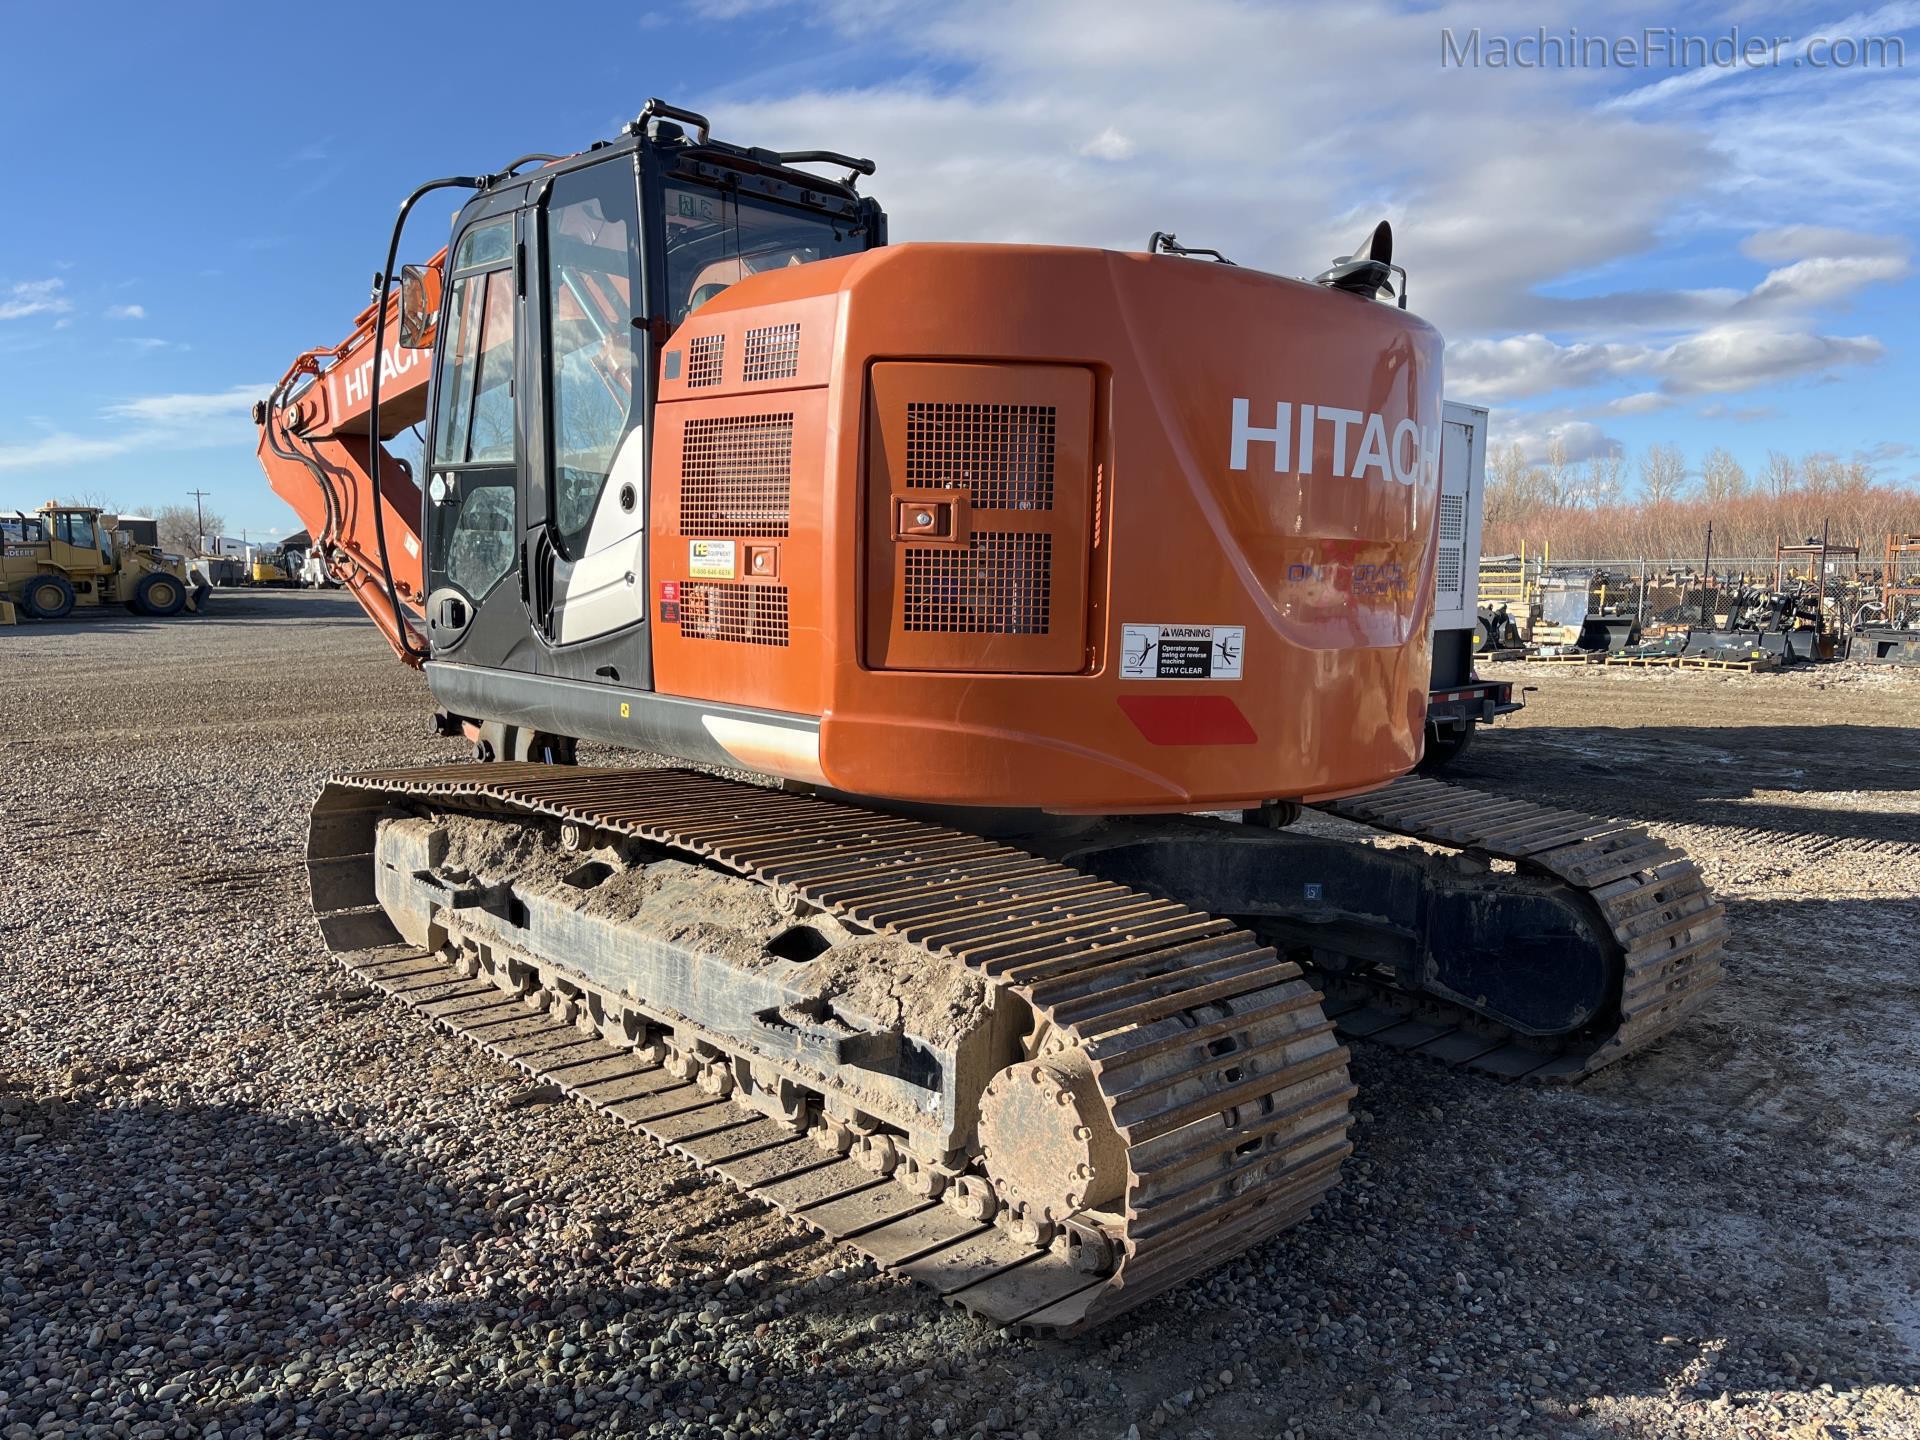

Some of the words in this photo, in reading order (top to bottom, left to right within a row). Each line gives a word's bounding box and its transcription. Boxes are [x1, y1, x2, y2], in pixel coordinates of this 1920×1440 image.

[1170, 628, 1211, 638] WARNING
[1161, 644, 1187, 652] Operator
[1161, 651, 1179, 659] swing
